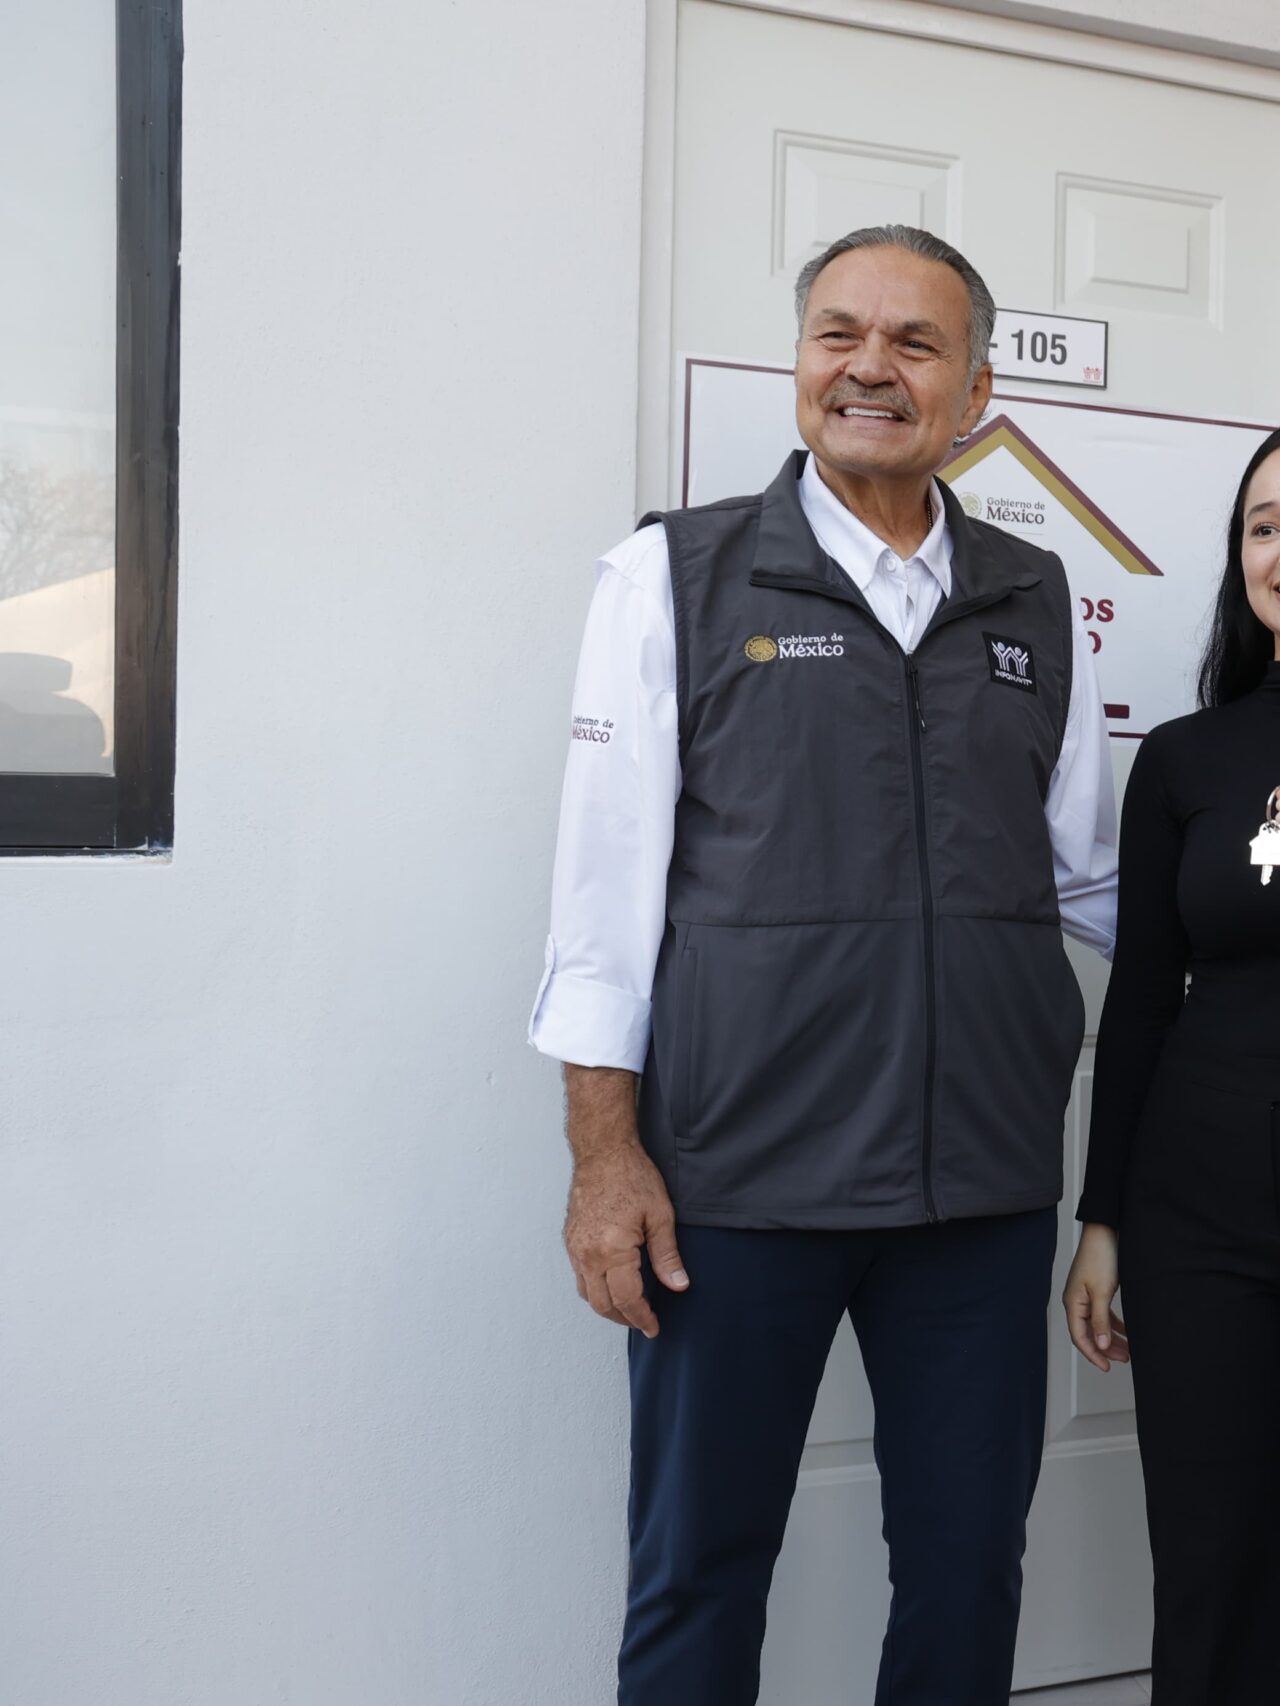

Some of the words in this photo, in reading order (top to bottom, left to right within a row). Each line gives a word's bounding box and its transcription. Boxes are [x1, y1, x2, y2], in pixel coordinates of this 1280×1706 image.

[1011, 329, 1067, 365] 105
[986, 497, 1032, 508] Gobierno
[1034, 501, 1046, 511] de
[986, 506, 1045, 525] México
[778, 635, 827, 645] Gobierno
[831, 632, 844, 642] de
[779, 642, 844, 659] México
[602, 718, 614, 729] de
